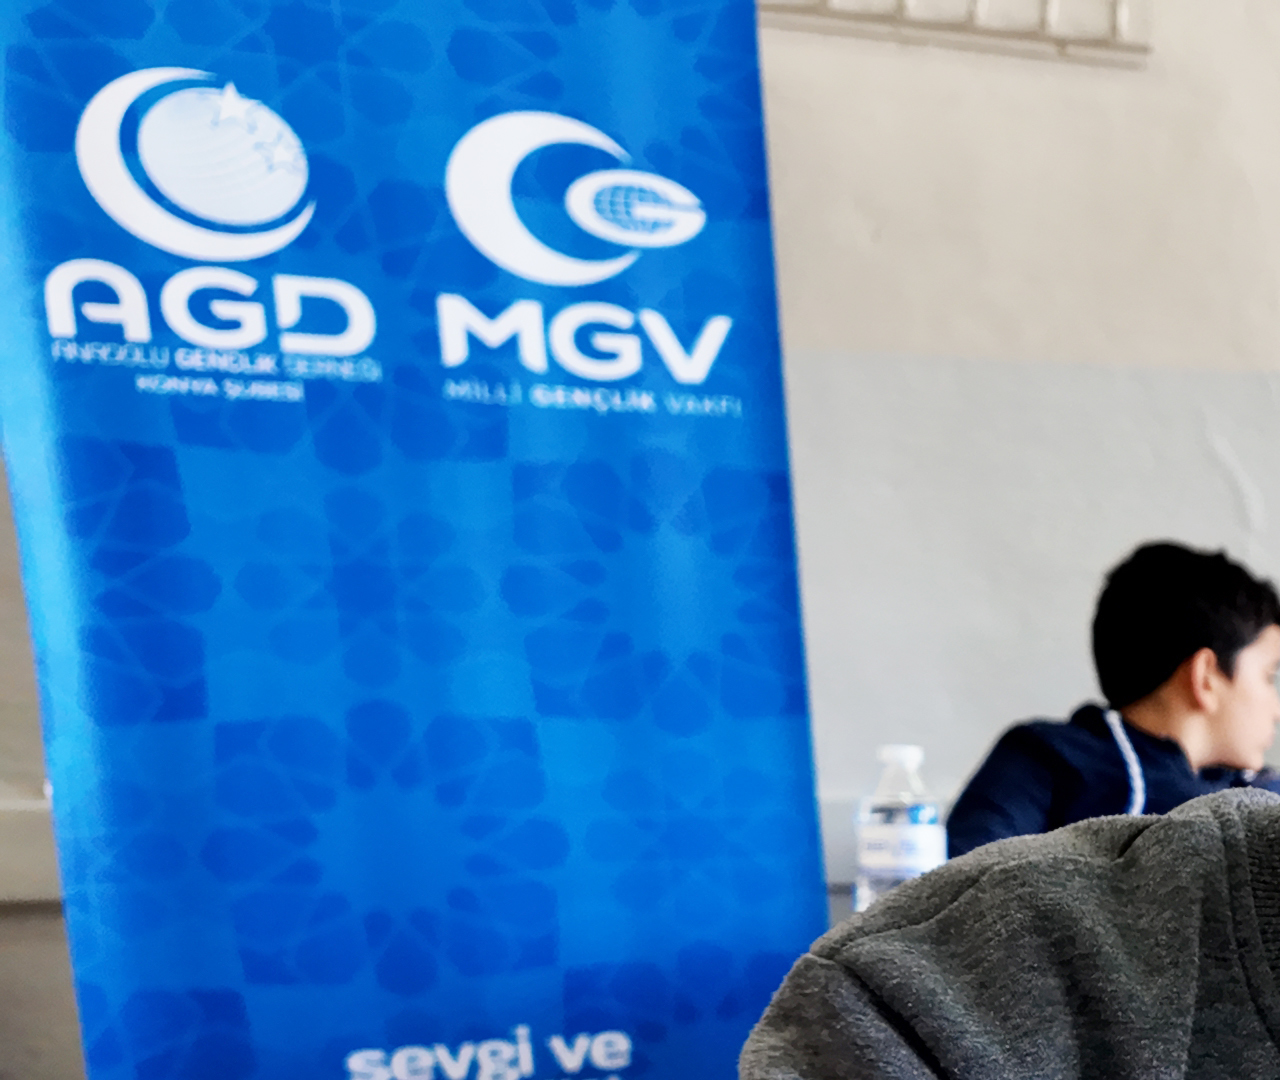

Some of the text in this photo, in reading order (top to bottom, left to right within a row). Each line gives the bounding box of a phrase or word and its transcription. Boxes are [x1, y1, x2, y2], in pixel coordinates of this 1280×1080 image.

[44, 257, 378, 357] AGD
[436, 291, 733, 384] MGV
[546, 1028, 633, 1074] ve
